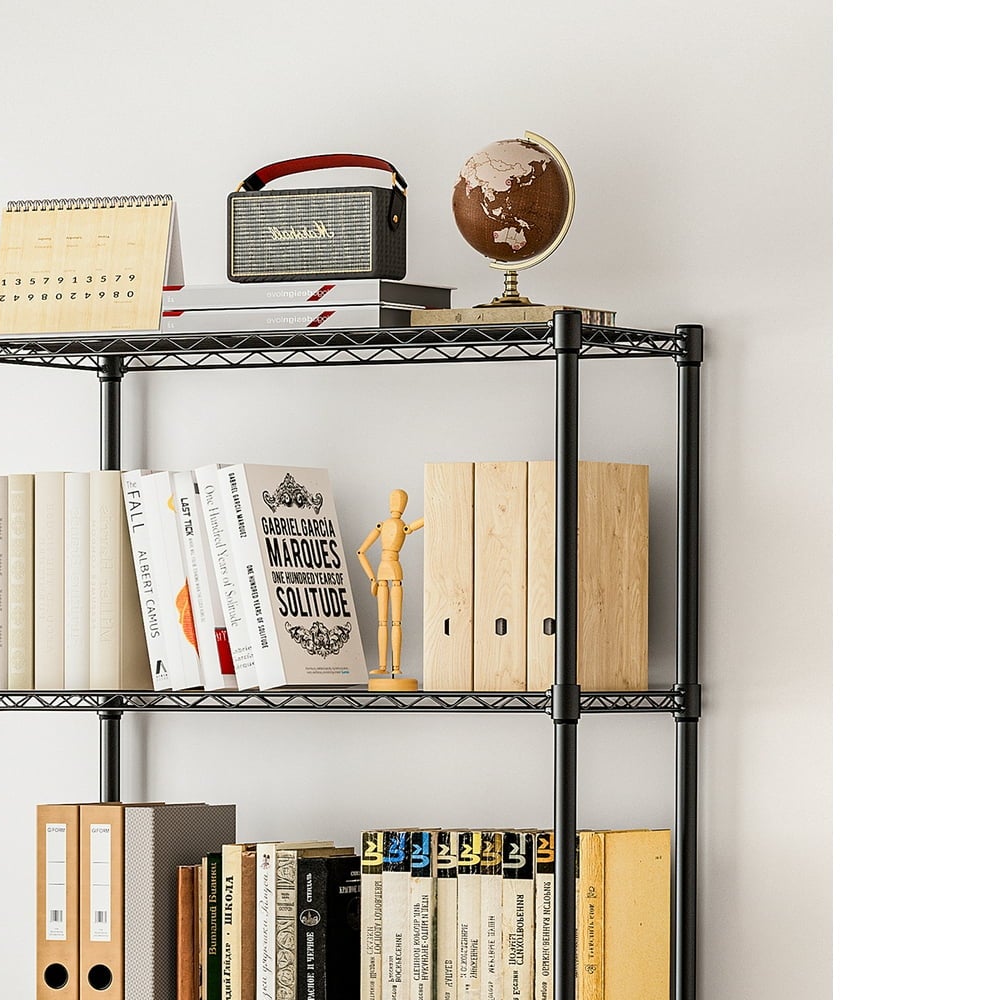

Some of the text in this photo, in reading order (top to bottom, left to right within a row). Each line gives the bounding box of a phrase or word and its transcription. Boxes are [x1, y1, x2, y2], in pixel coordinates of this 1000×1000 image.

[15, 278, 21, 286] 3
[58, 276, 64, 284] 9
[72, 276, 77, 284] 1
[129, 274, 135, 282] 9
[228, 472, 238, 494] GABRIEL
[128, 490, 144, 534] FALL
[180, 497, 194, 537] LAST TICK
[261, 516, 336, 538] GABRIEL GARCÍA
[207, 507, 226, 549] Hundred
[225, 589, 242, 627] Solitude
[265, 538, 341, 570] MÁRQUES
[138, 550, 160, 639] ALBERT CAMUS
[272, 571, 344, 586] ONE HUNDRED YEARS OF
[276, 586, 351, 618] SOLITUDE
[225, 876, 234, 925] ШКОЛА
[306, 932, 314, 962] ЧЕРНОЕ
